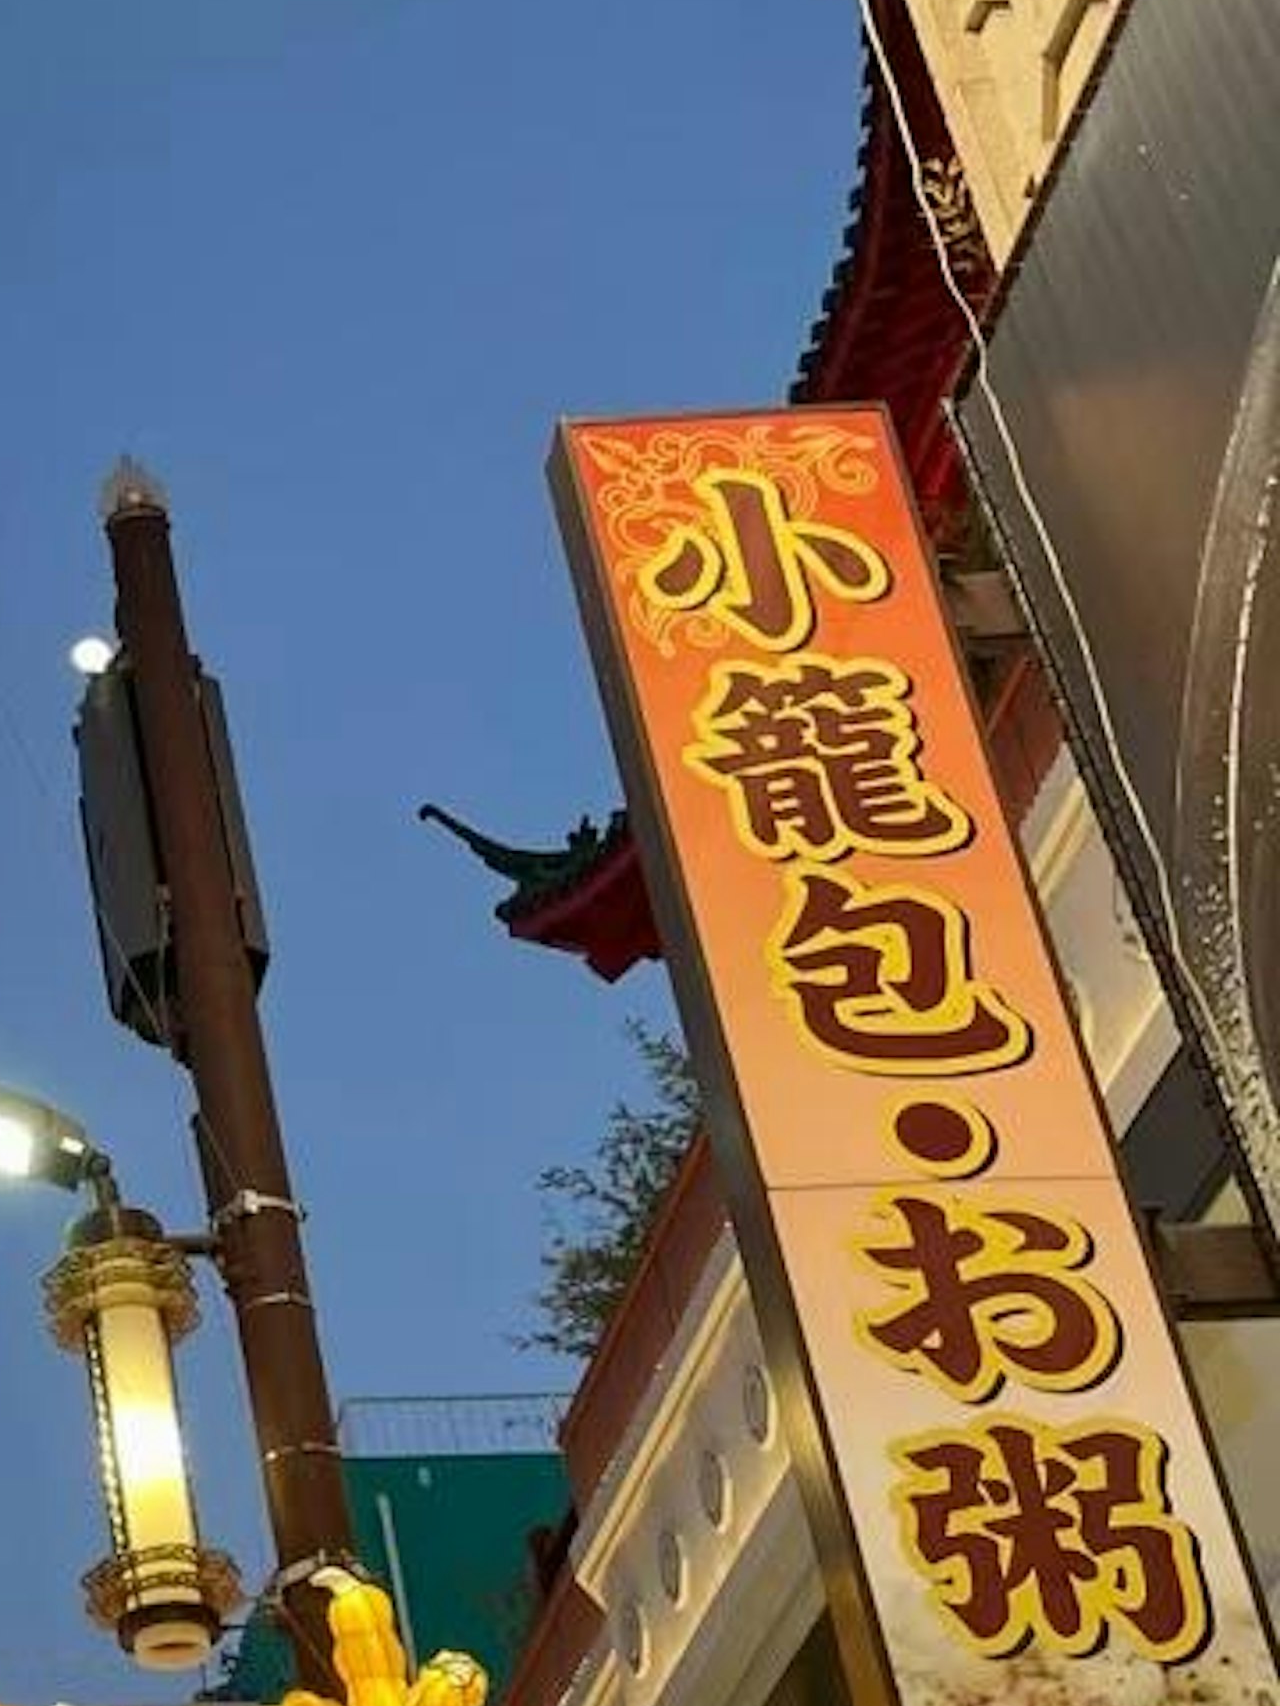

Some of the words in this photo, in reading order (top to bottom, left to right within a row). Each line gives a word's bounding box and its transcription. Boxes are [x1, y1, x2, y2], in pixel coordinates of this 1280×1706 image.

[642, 469, 1208, 1663] 小籠包・お粥
